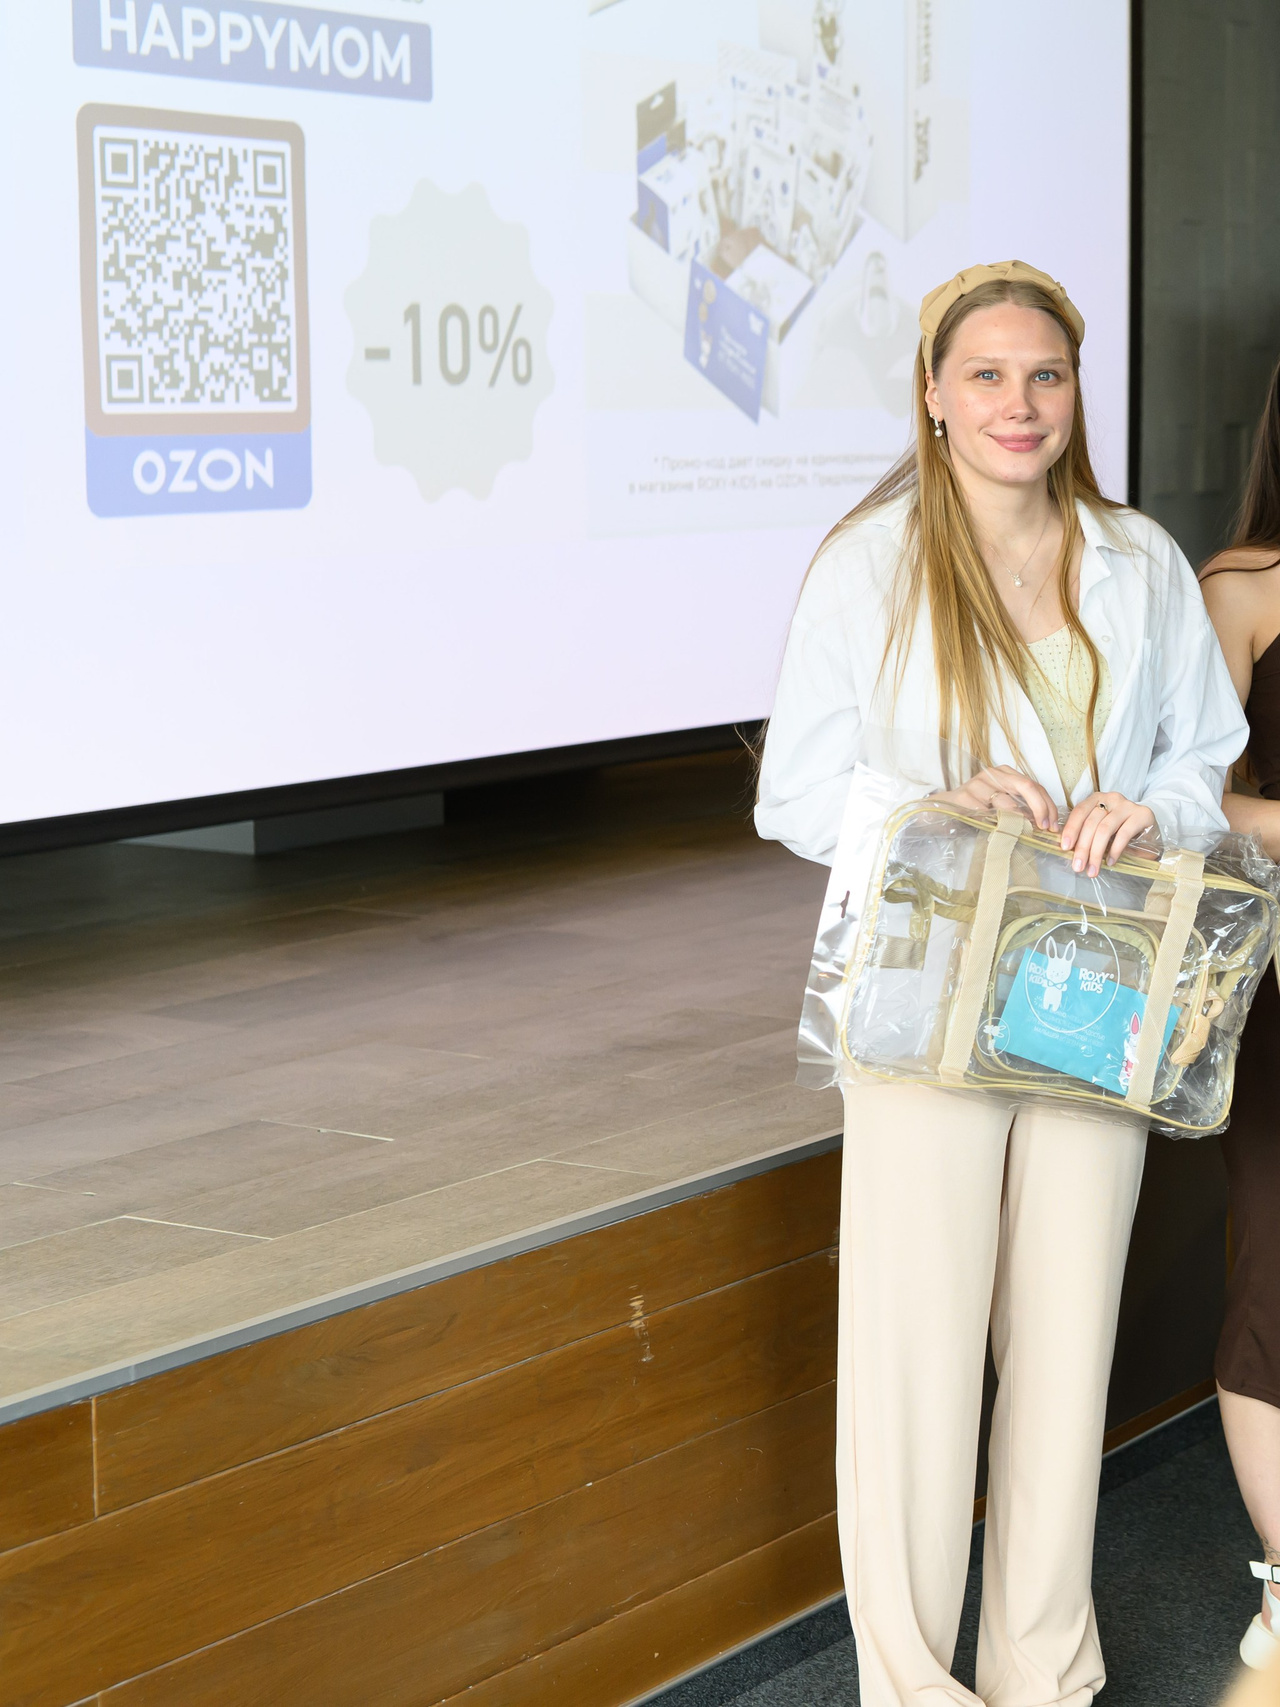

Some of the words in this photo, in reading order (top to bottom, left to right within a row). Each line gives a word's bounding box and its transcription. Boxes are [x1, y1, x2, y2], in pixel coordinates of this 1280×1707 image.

[100, 0, 411, 85] HAPPYMOM
[365, 303, 533, 389] -10%
[132, 447, 274, 495] OZON
[1079, 968, 1109, 983] ROXY
[1080, 982, 1103, 993] KIDS
